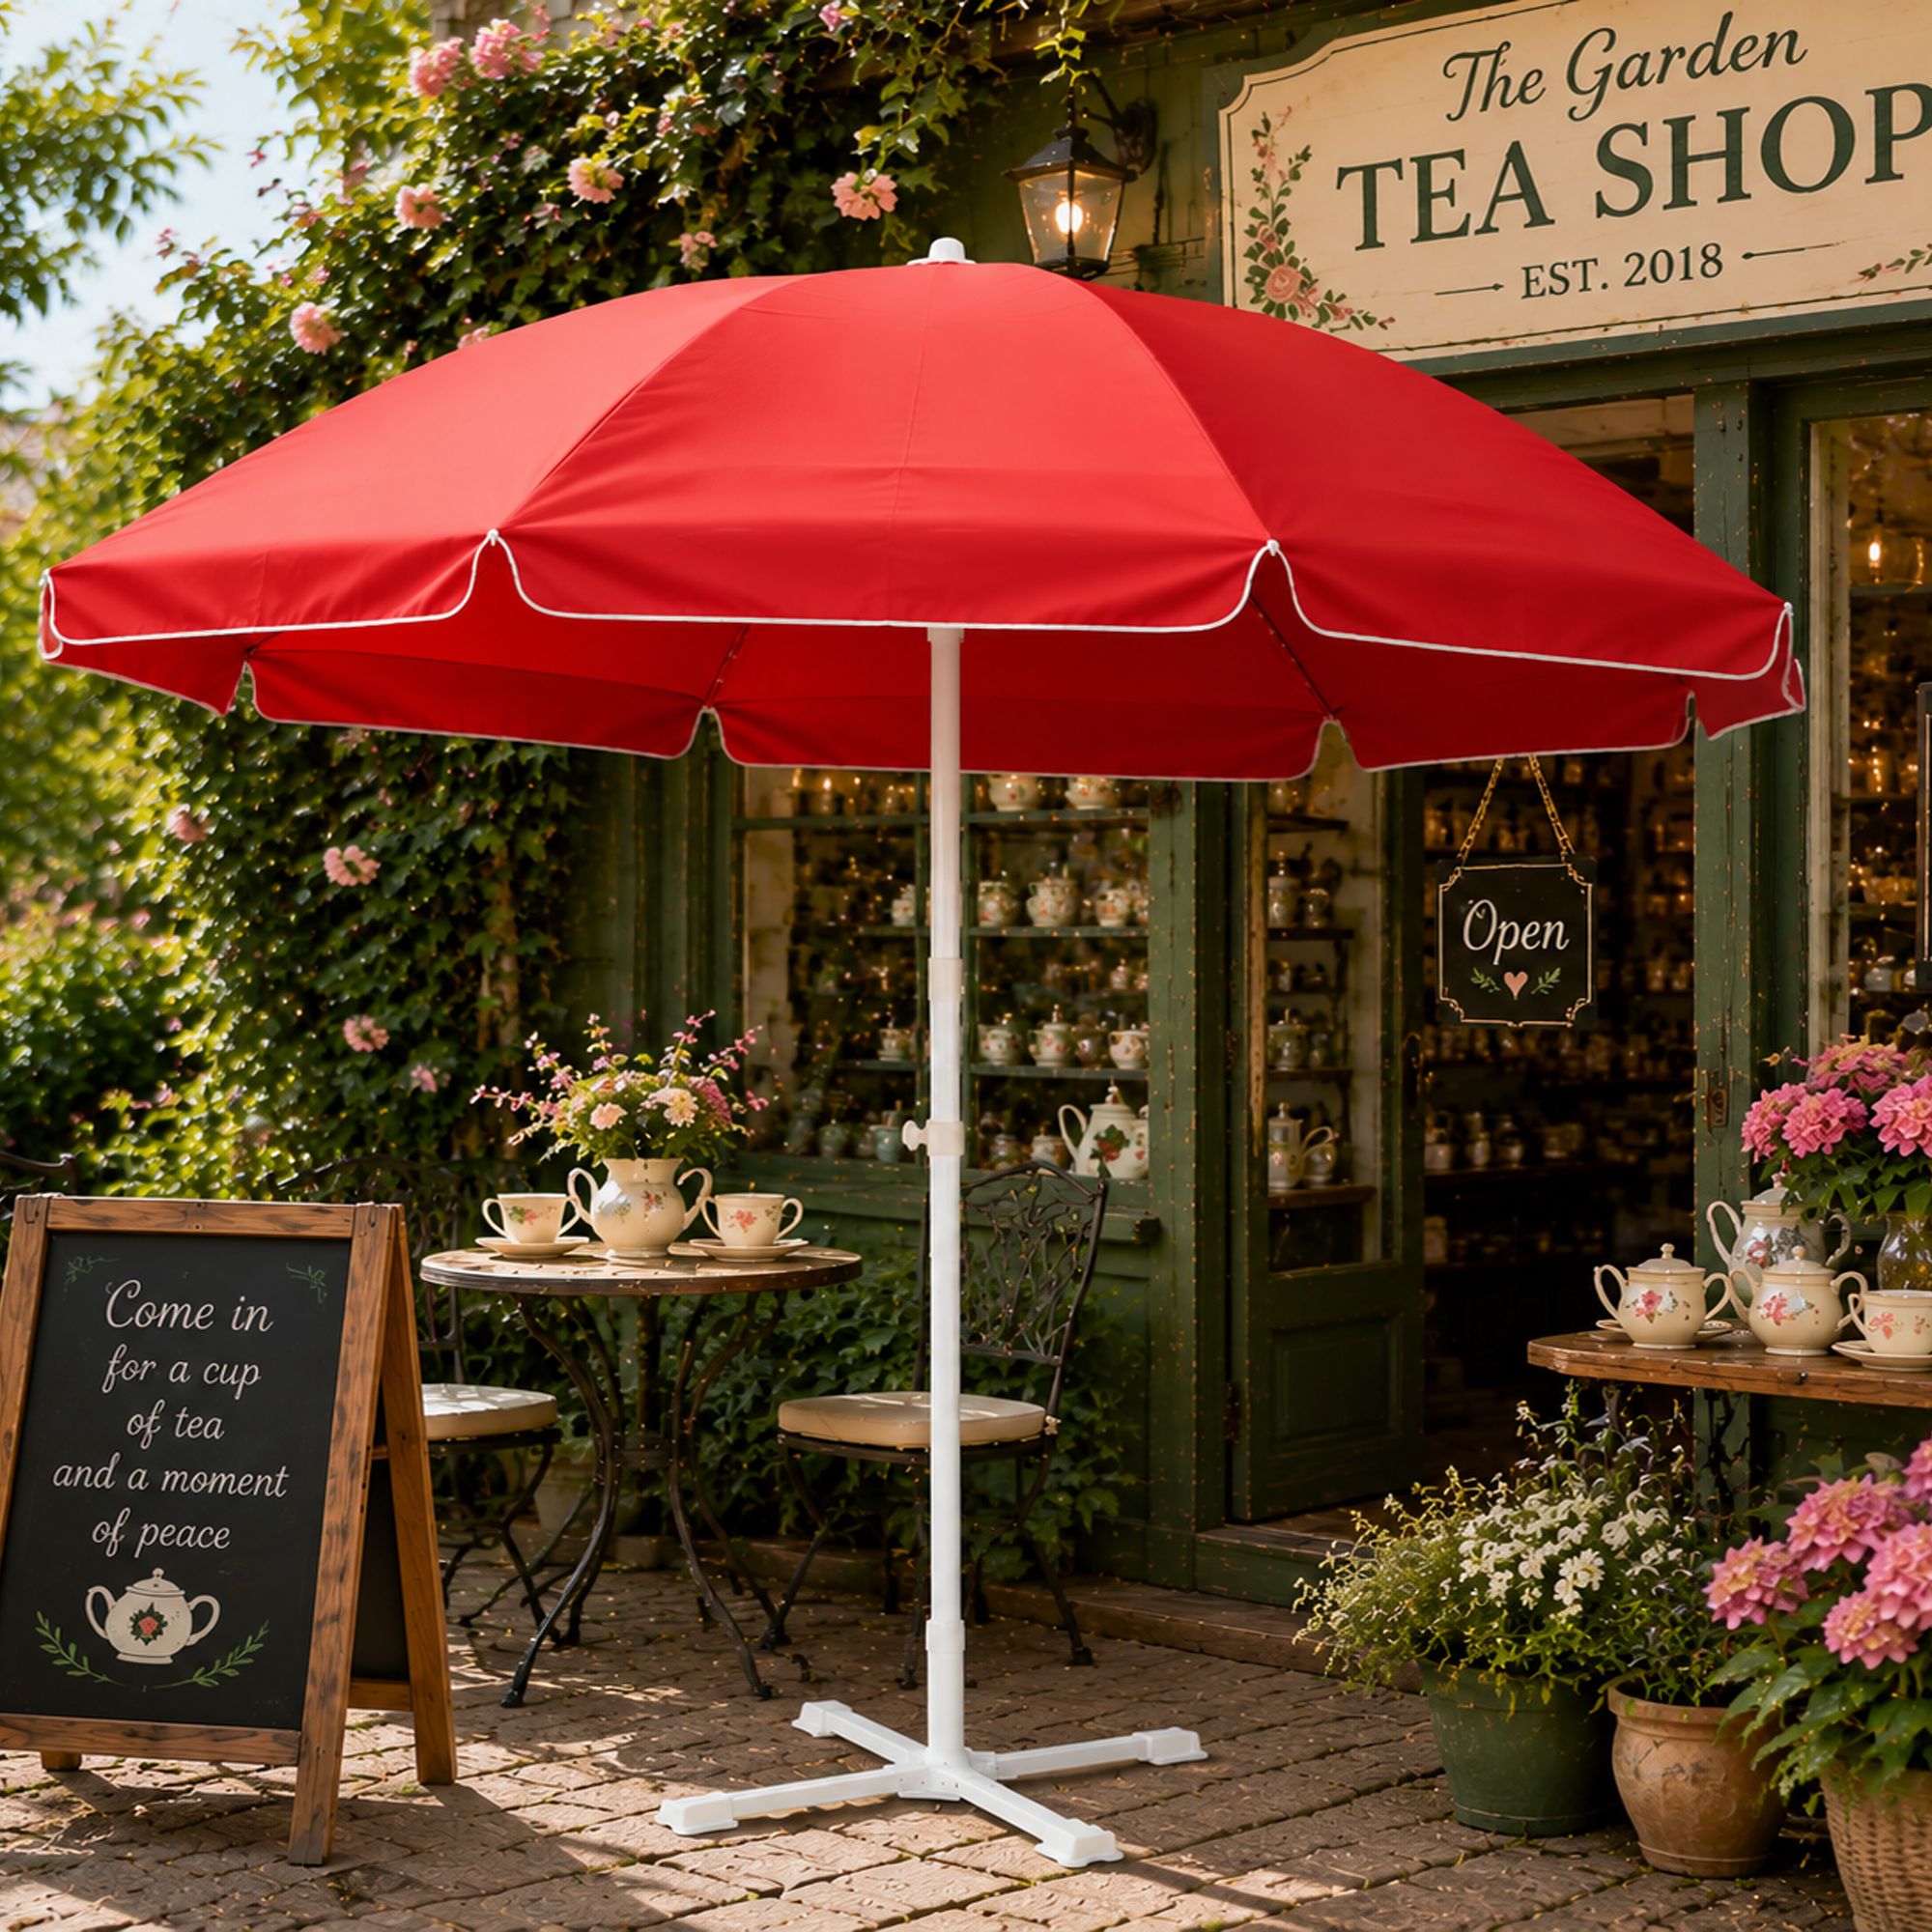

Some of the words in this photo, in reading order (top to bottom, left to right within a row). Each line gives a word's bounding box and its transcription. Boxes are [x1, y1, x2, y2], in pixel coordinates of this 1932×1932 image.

[1442, 41, 1546, 122] The
[1567, 10, 1807, 122] Garden
[1336, 140, 1554, 252] TEA
[1595, 83, 1932, 219] SHOP
[1521, 257, 1608, 299] EST.
[1625, 242, 1723, 288] 2018
[1463, 899, 1570, 965] Open
[105, 1280, 213, 1331] Come
[231, 1295, 273, 1333] in
[102, 1345, 156, 1393] for
[169, 1362, 190, 1383] a
[203, 1362, 262, 1400] cup
[128, 1399, 164, 1450] of
[175, 1405, 224, 1440] tea
[53, 1453, 120, 1490] and
[128, 1469, 149, 1491] a
[161, 1465, 289, 1498] moment
[92, 1507, 131, 1557] of
[135, 1524, 231, 1558] peace
